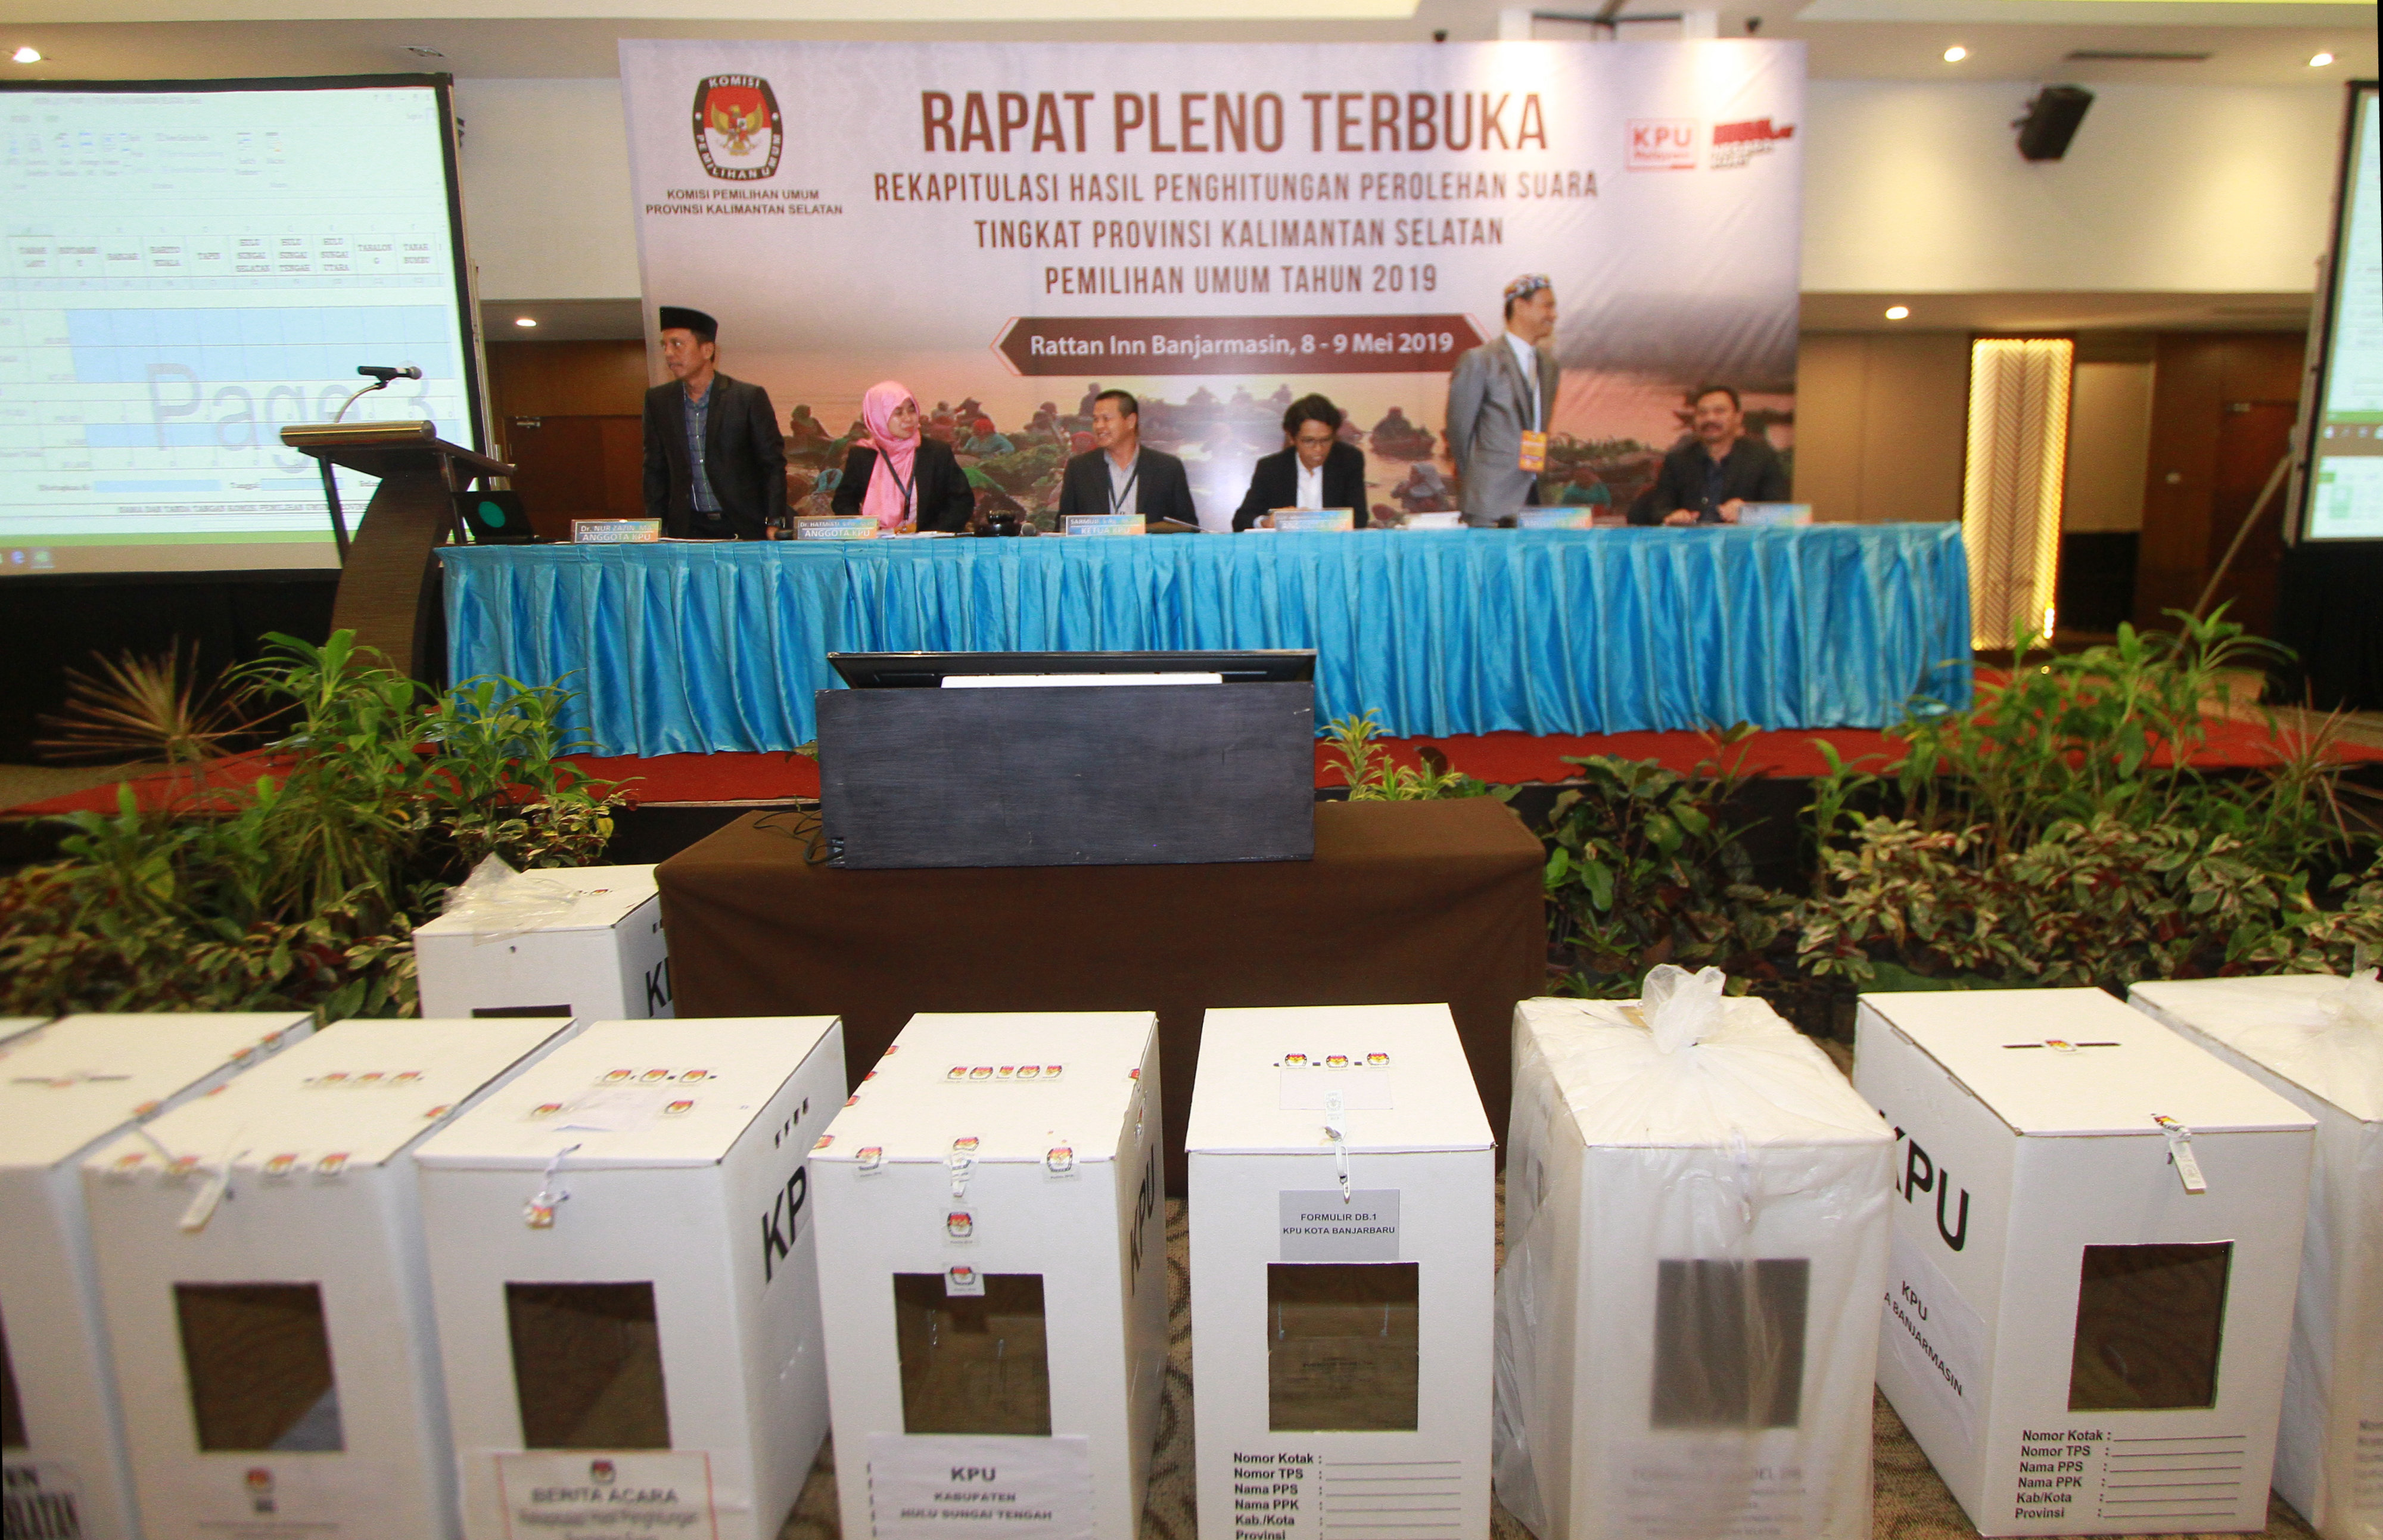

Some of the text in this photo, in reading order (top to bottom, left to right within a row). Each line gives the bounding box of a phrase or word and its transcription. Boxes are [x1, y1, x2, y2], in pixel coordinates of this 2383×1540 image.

[708, 76, 760, 88] KOMISI
[922, 91, 1549, 153] RAPAT PLENO TERBUKA
[1634, 126, 1691, 147] KPU
[696, 133, 782, 179] PEMILIHAN UMUM
[875, 170, 1598, 202] REKAPITULASI HASIL PENGHITUNGAN PEROLEHAN SUARA
[667, 189, 819, 200] KOMISI PEMILIHAN UMUM
[646, 204, 843, 215] PROVINSI KALIMANTAN SELATAN
[975, 217, 1504, 248] TINGKAT PROVINSI KALIMANTAN SELATAN
[1046, 264, 1438, 294] PEMILIHAN UMUM TAHUN 2019
[1031, 335, 1104, 355] Rattan
[1110, 336, 1145, 354] Inn
[1152, 334, 1296, 359] Banjarmasin,
[1301, 334, 1315, 353] 8
[1333, 333, 1346, 352] 9
[1352, 333, 1393, 352] Mei
[1398, 332, 1453, 351] 2019
[145, 363, 362, 474] Page
[1081, 526, 1110, 534] KETUA
[762, 1165, 807, 1283] KP
[1131, 1143, 1155, 1298] KPU
[1902, 1280, 1928, 1322] KPU
[1893, 1300, 1963, 1396] BANJARMASIN
[2023, 1430, 2064, 1441] Nomor
[2067, 1429, 2102, 1441] Kotak
[2021, 1445, 2062, 1456] Nomor
[2066, 1445, 2090, 1455] TPS
[1234, 1452, 1275, 1463] Nomor
[1278, 1452, 1314, 1463] Kotak
[2020, 1461, 2054, 1472] Nama
[2057, 1461, 2083, 1471] PPS
[951, 1467, 995, 1482] KPU
[1234, 1468, 1275, 1479] Nomor
[1279, 1468, 1303, 1479] TPS
[2018, 1477, 2052, 1488] Nama
[2055, 1476, 2083, 1487] PPK
[1235, 1483, 1269, 1494] Nama
[1273, 1483, 1298, 1494] PPS
[532, 1488, 679, 1502] BERITA ACARA
[934, 1492, 1016, 1501] KABUPATEN
[2016, 1492, 2071, 1503] Kab/Kota
[1235, 1499, 1270, 1510] Nama
[1273, 1499, 1299, 1510] PPK
[901, 1508, 1052, 1520] HULU SUNGAI TENGAH
[2015, 1507, 2064, 1518] Provinsi
[1236, 1514, 1295, 1525] Kab./Kota
[1236, 1529, 1286, 1540] Provinsi
